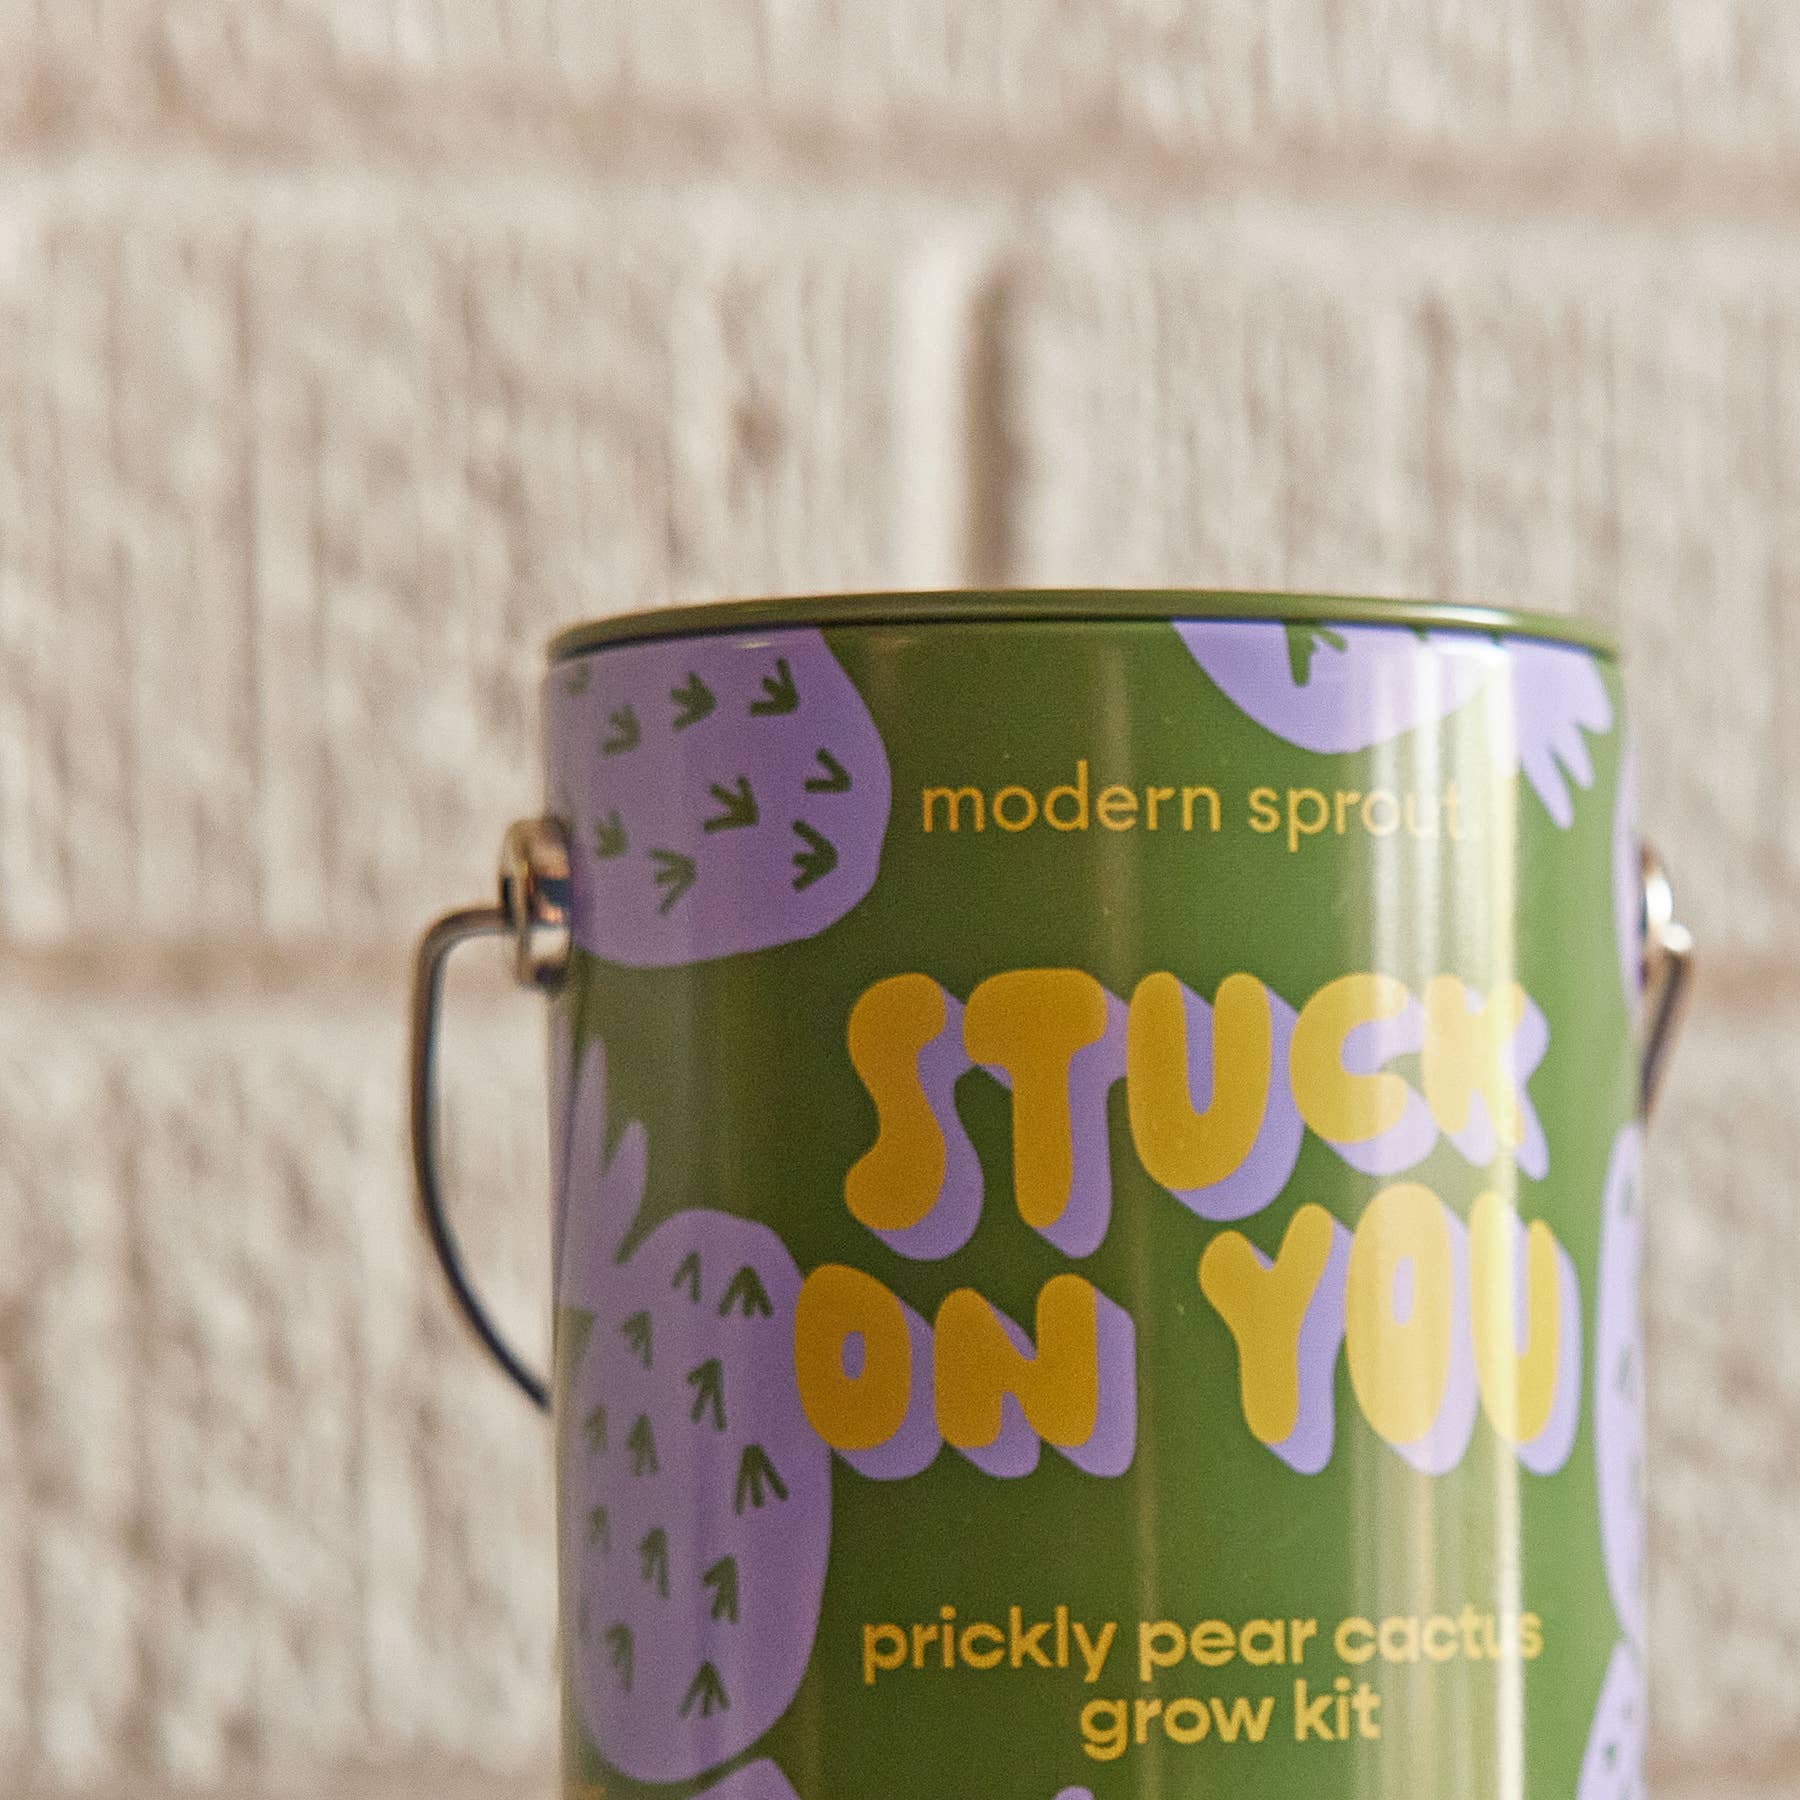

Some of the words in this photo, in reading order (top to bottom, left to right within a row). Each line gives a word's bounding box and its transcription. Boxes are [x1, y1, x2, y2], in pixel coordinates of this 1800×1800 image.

[922, 760, 1222, 834] modern
[845, 967, 1548, 1260] STUCK
[794, 1264, 1137, 1480] ON
[1199, 1182, 1583, 1474] YOU
[861, 1606, 1116, 1684] prickly
[1138, 1614, 1318, 1682] pear
[1334, 1603, 1545, 1666] cactus
[1081, 1690, 1276, 1762] grow
[1295, 1678, 1383, 1742] kit
